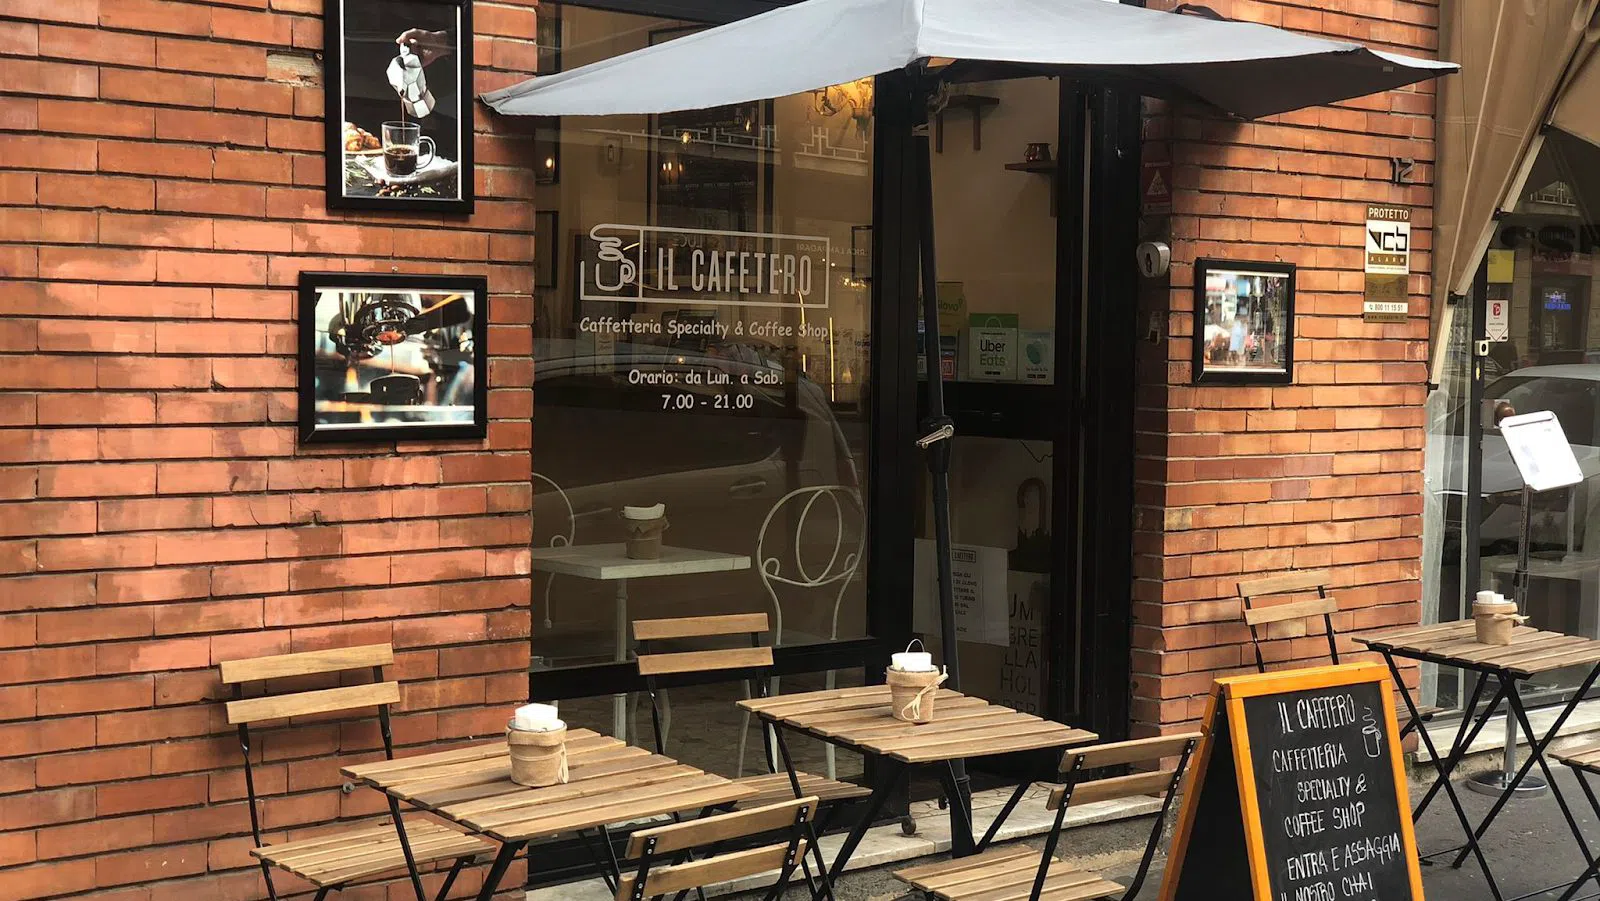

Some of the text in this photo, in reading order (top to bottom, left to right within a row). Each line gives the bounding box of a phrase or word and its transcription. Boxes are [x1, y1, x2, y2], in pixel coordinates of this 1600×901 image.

[1392, 157, 1415, 183] 12
[1368, 207, 1409, 220] PROTETTO
[657, 247, 812, 297] IL CAFETERO
[579, 316, 829, 342] Caffetteria Specialty & Coffee Shop
[980, 339, 1006, 353] Uber
[979, 353, 1006, 367] Eats
[628, 368, 784, 386] Orario: da Lun. a Sab.
[661, 394, 694, 410] 7.00
[714, 394, 754, 410] 21.00
[1277, 694, 1356, 734] IL CAFETERO
[1272, 742, 1348, 772] CAFFETTERIA
[1297, 773, 1367, 802] SPECIALTY &
[1284, 801, 1366, 838] COFFEE SHOP
[1286, 832, 1401, 881] ENTRA E ASSAGGIA
[1296, 871, 1374, 901] NOSTRO CHAI
